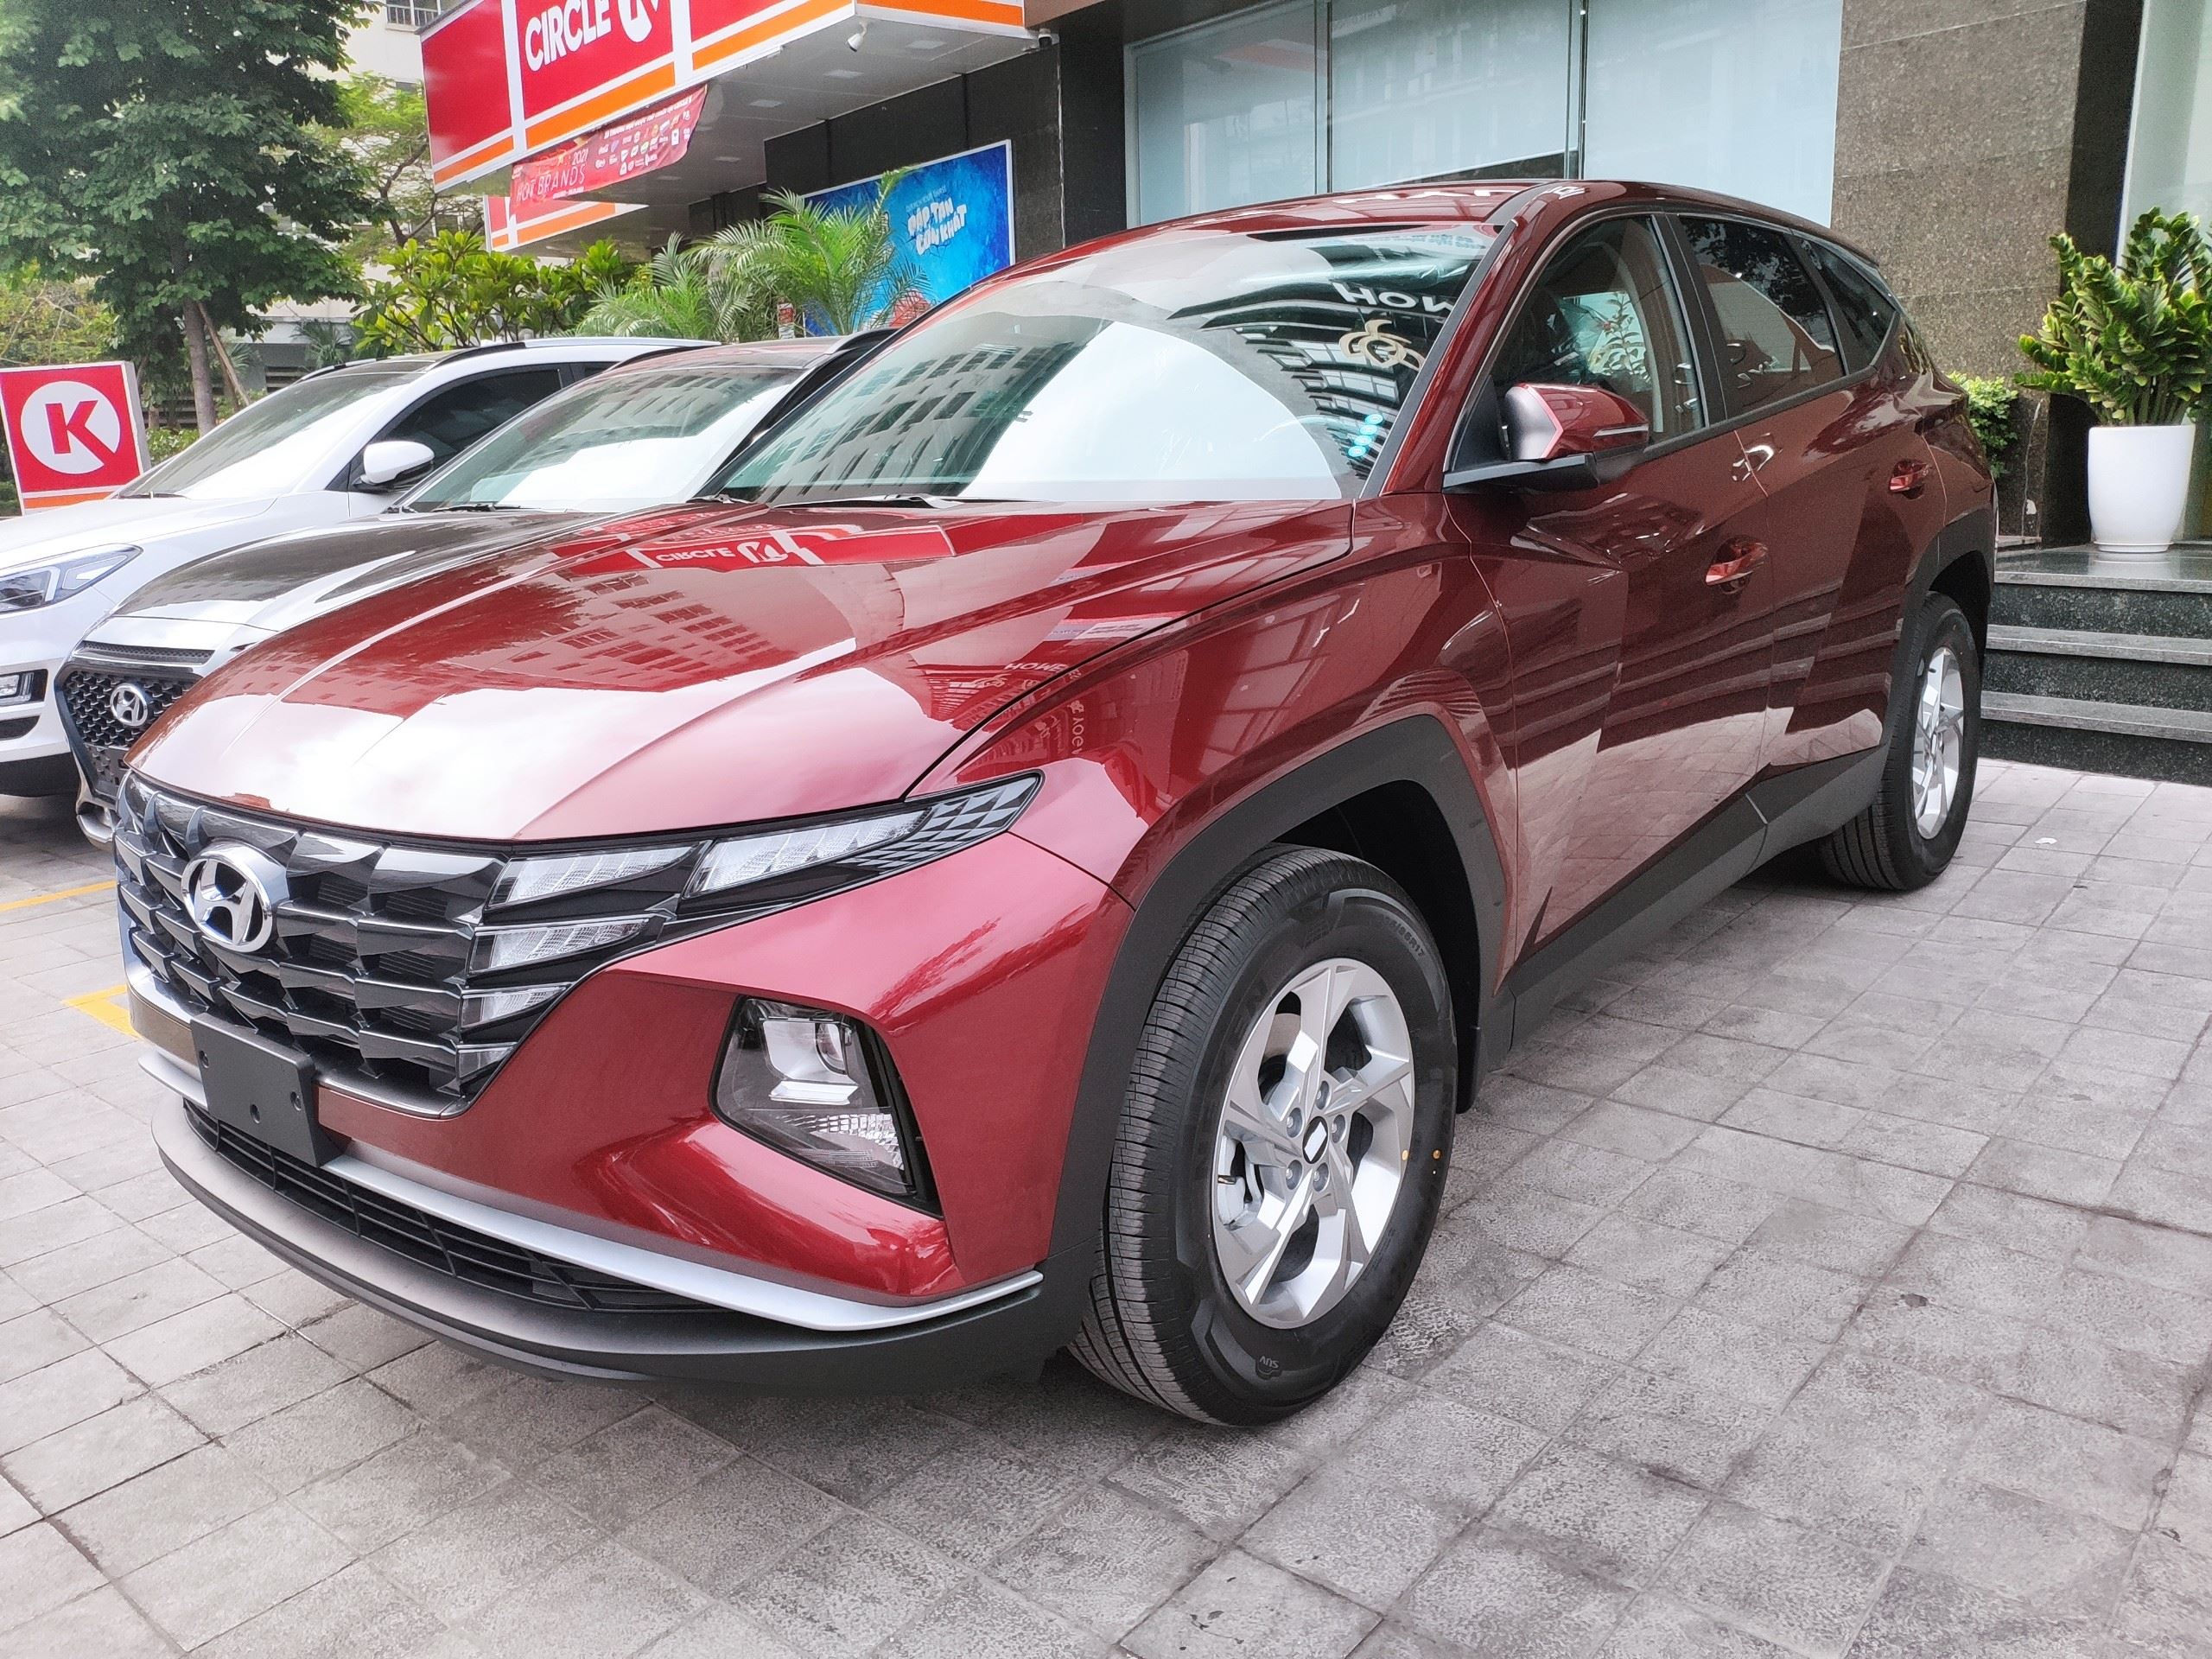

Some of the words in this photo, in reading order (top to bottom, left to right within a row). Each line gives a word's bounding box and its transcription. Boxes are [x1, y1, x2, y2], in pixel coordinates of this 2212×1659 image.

[525, 0, 611, 72] CIRCLE
[537, 163, 587, 196] BRANDS
[1259, 1355, 1279, 1369] SUV
